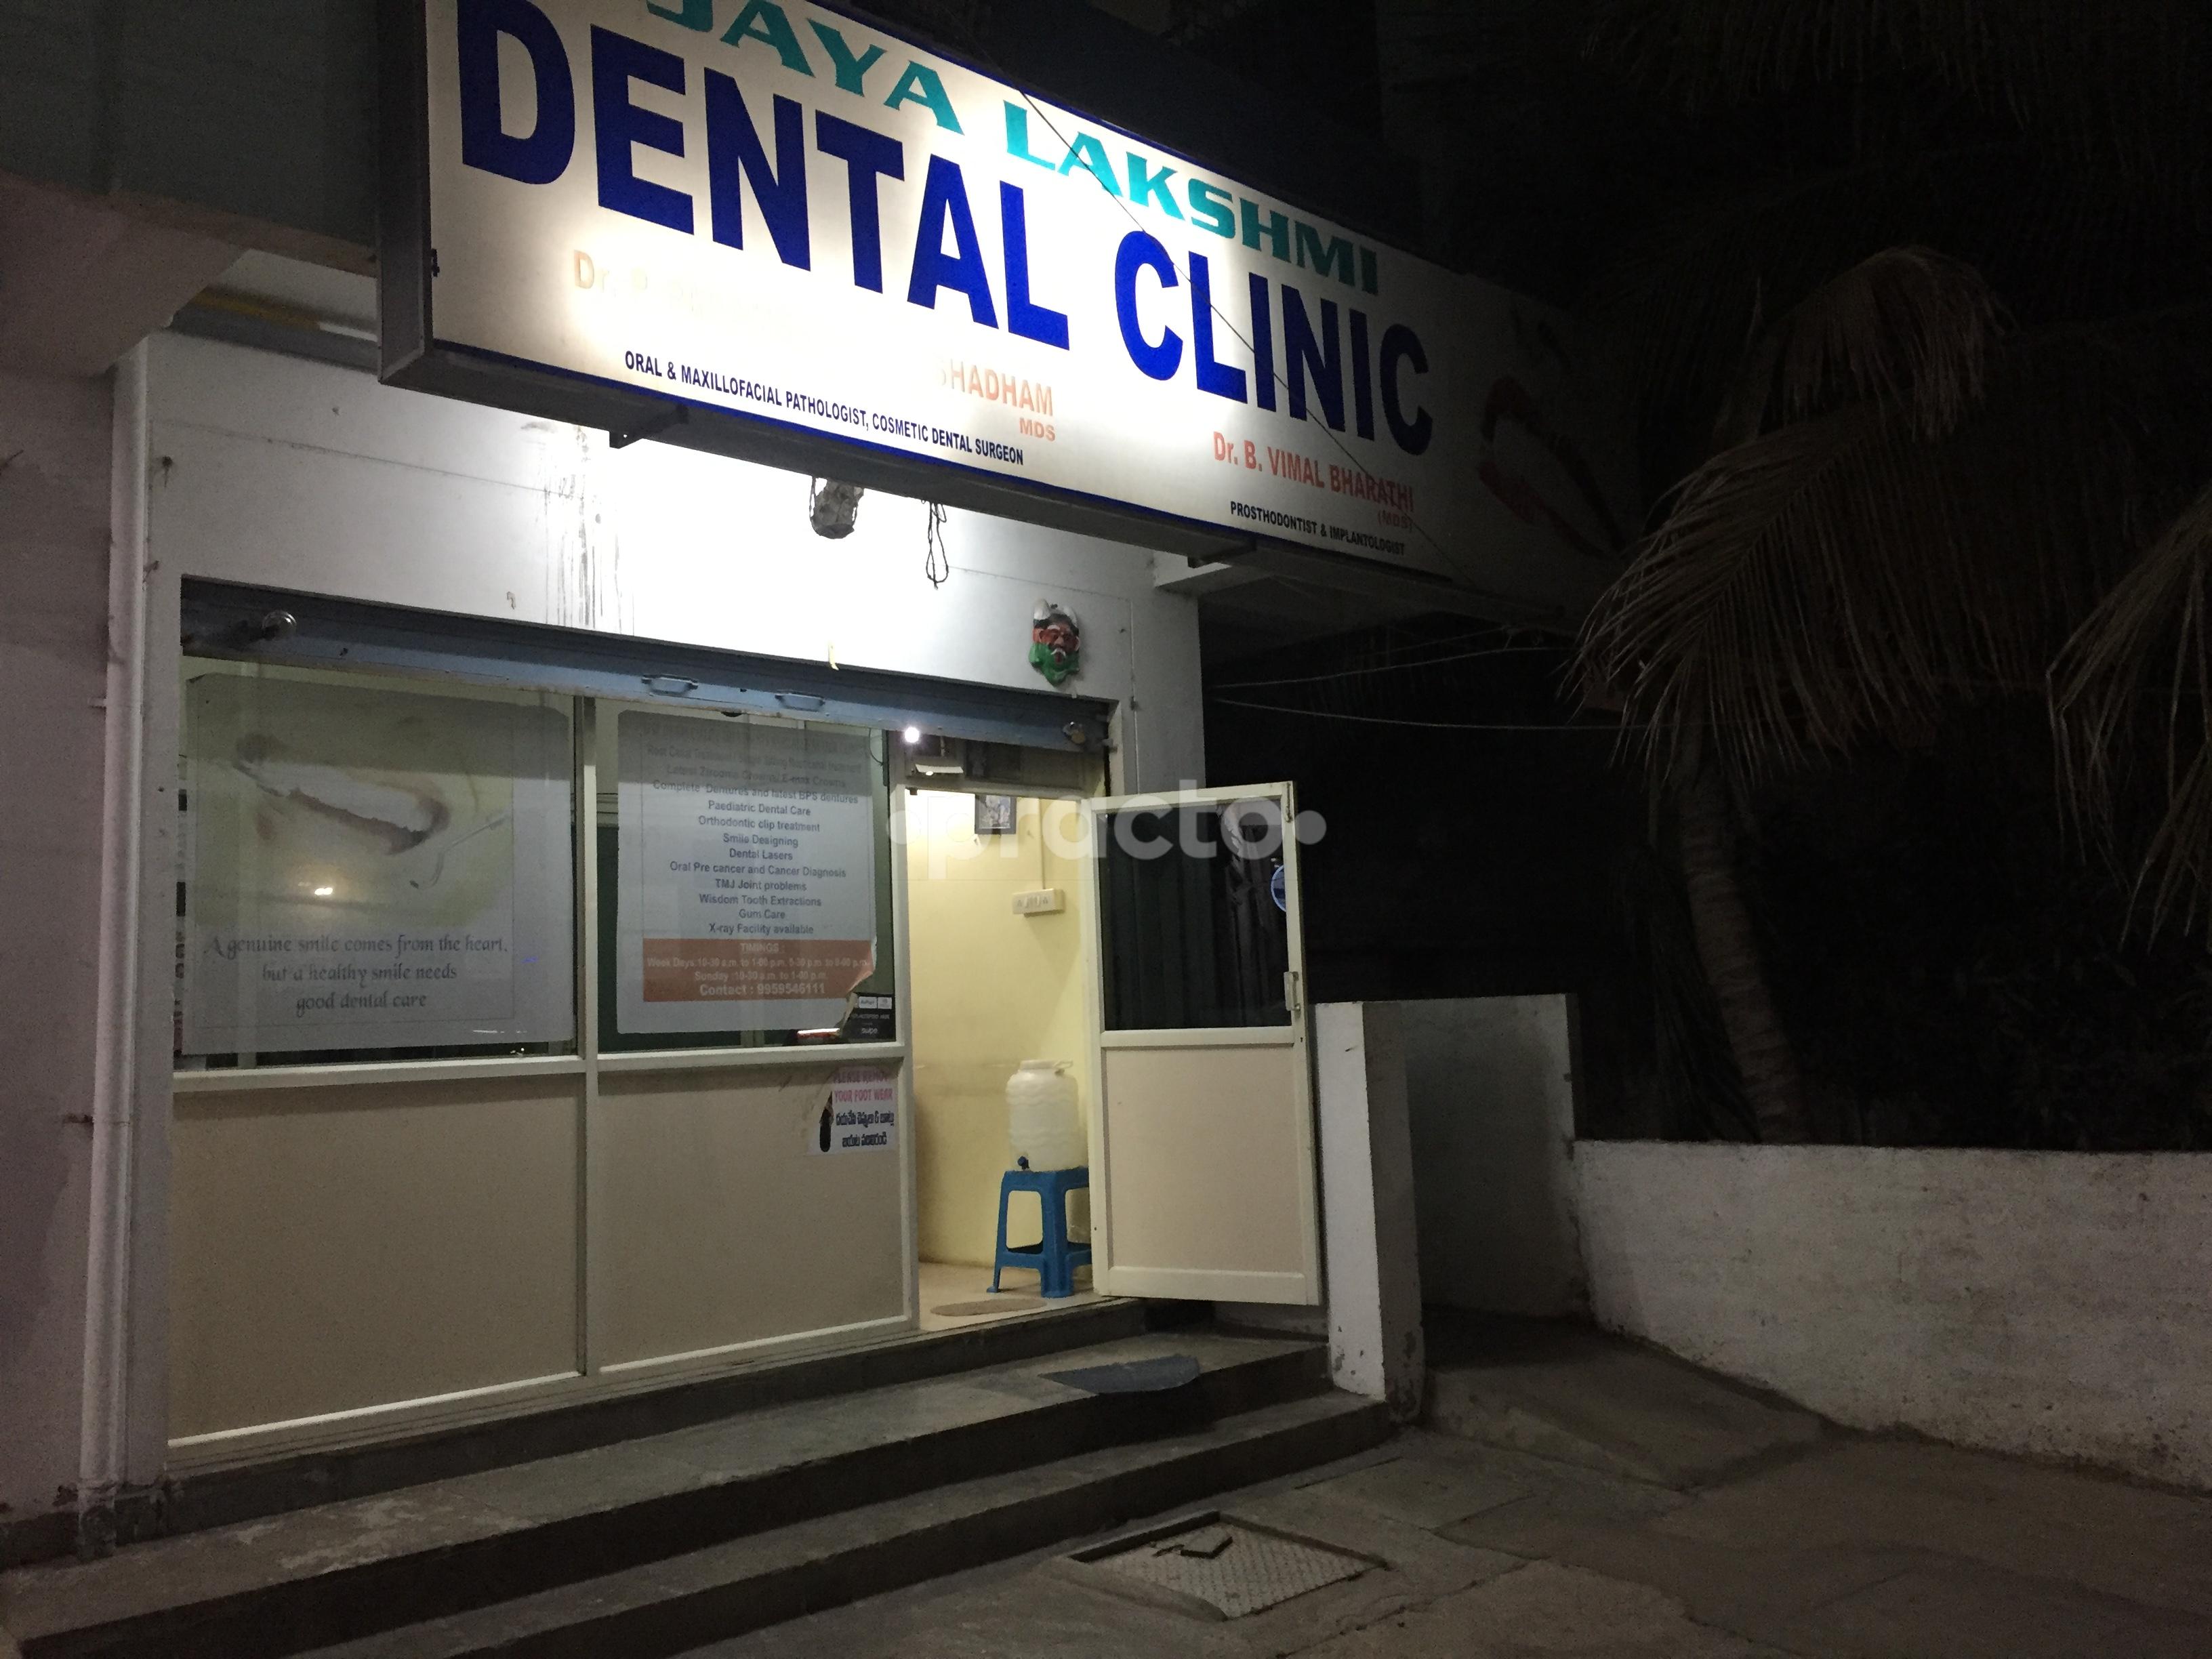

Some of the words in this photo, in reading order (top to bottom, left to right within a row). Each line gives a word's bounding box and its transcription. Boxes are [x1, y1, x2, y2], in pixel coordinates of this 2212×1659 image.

[1004, 100, 1379, 296] LAKSHMI
[456, 0, 1070, 351] DENTAL
[1114, 230, 1433, 456] CLINIC
[625, 350, 662, 377] ORAL
[667, 361, 676, 381] &
[681, 365, 782, 406] MAXILLOFACIAL
[786, 390, 869, 431] PATHOLOGIST,
[872, 413, 928, 443] COSMETIC
[932, 428, 972, 453] DENTAL
[975, 438, 1023, 466] SURGEON
[1019, 417, 1056, 442] MDS
[1213, 431, 1238, 466] Dr.
[1244, 440, 1263, 472] B.
[1267, 446, 1324, 489] VIMAL
[1329, 464, 1414, 513] BHARATHI
[1231, 501, 1317, 535] PROSTHODONTIST
[1321, 524, 1327, 537] &
[1330, 525, 1405, 556] IMPLANTOLOGIST
[653, 779, 700, 792] Complete
[752, 788, 769, 798] and
[771, 790, 797, 800] latest
[799, 791, 818, 801] BPS
[821, 792, 859, 804] dentures
[708, 800, 756, 813] Paediatric
[758, 803, 788, 815] Dental
[790, 805, 811, 815] Care
[698, 815, 756, 830] Orthodontic
[758, 819, 775, 832] clip
[777, 820, 821, 832] treatment
[723, 833, 750, 844] Smile
[752, 835, 798, 848] Designing
[729, 848, 760, 860] Dental
[762, 850, 793, 861] Lasers
[670, 861, 691, 872] Oral
[694, 861, 710, 873] Pre
[713, 864, 745, 874] cancer
[747, 863, 766, 874] and
[768, 864, 800, 876] Cancer
[803, 866, 846, 879] Diagnosis
[715, 878, 735, 890] TMJ
[738, 879, 762, 890] Joint
[764, 880, 807, 893] problems
[699, 894, 739, 905] Wisdom
[741, 895, 768, 905] Tooth
[771, 895, 822, 907] Extractions
[739, 908, 762, 920] Gum
[764, 909, 785, 920] Care
[709, 923, 734, 935] X-ray
[737, 924, 771, 936] Facility
[773, 924, 814, 935] available
[227, 934, 292, 960] genuine
[344, 939, 392, 952] comes
[394, 934, 434, 959] from
[438, 934, 461, 952] the
[262, 963, 288, 981] but
[293, 968, 304, 981] a
[309, 962, 367, 989] healthy
[371, 962, 411, 981] smile
[415, 962, 458, 981] needs
[699, 983, 747, 996] Contact
[295, 991, 336, 1019] good
[340, 989, 389, 1009] dental
[392, 994, 427, 1008] care
[855, 1088, 872, 1102] FOOT
